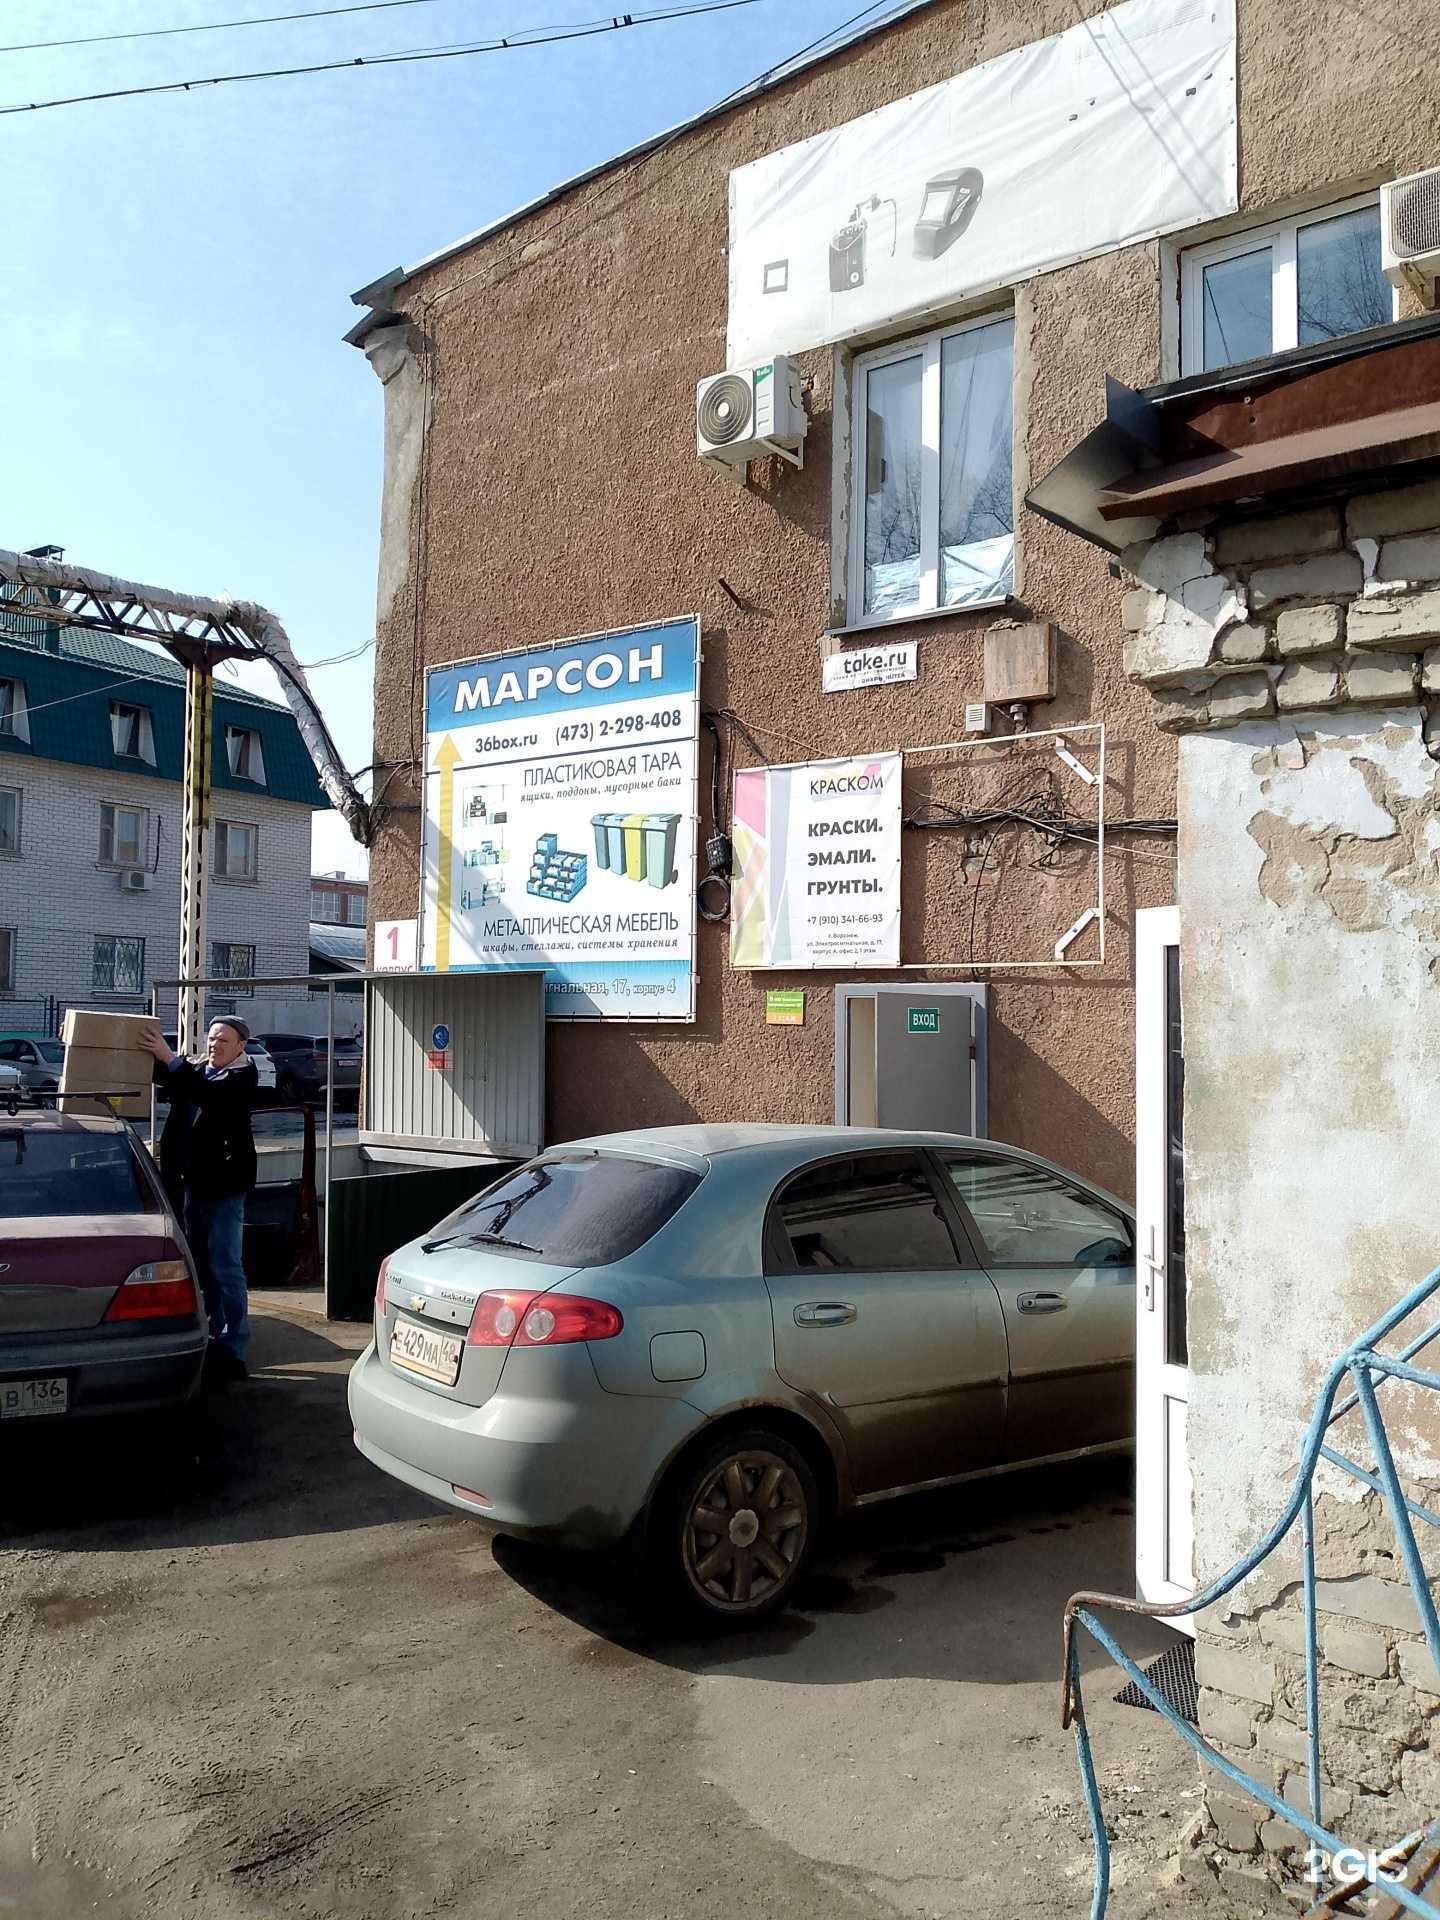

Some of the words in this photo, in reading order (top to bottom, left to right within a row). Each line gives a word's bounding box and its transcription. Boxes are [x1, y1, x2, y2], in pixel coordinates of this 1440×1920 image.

[843, 652, 907, 674] take.ru
[454, 644, 663, 713] МАРСОН
[475, 733, 537, 753] 36box.ru
[556, 721, 594, 746] (473)
[600, 709, 681, 737] 2-298-408
[524, 755, 636, 787] ПЛАСТИКОВАЯ
[641, 751, 681, 773] ТАРА
[520, 790, 554, 804] ящики,
[556, 785, 601, 801] поддоны,
[604, 780, 654, 797] мусорные
[657, 776, 682, 788] баки
[810, 775, 883, 796] КРАСКОМ
[808, 817, 883, 838] КРАСКИ.
[807, 848, 876, 867] ЭМАЛИ.
[807, 878, 883, 896] ГРУНТЫ.
[483, 915, 611, 937] МЕТАЛЛИЧЕСКАЯ
[616, 912, 679, 932] МЕБЕЛЬ
[807, 916, 816, 925] +7
[819, 915, 839, 926] (910)
[841, 914, 883, 924] 341-66-93
[387, 926, 399, 960] 1
[482, 942, 519, 953] шкафы,
[521, 941, 574, 952] стеллажи,
[577, 938, 623, 950] системы
[627, 938, 678, 951] хранения
[612, 979, 631, 995] 17,
[633, 984, 664, 996] корпус
[667, 978, 677, 993] 4
[913, 1013, 936, 1027] ВХОД
[26, 1380, 60, 1398] 136
